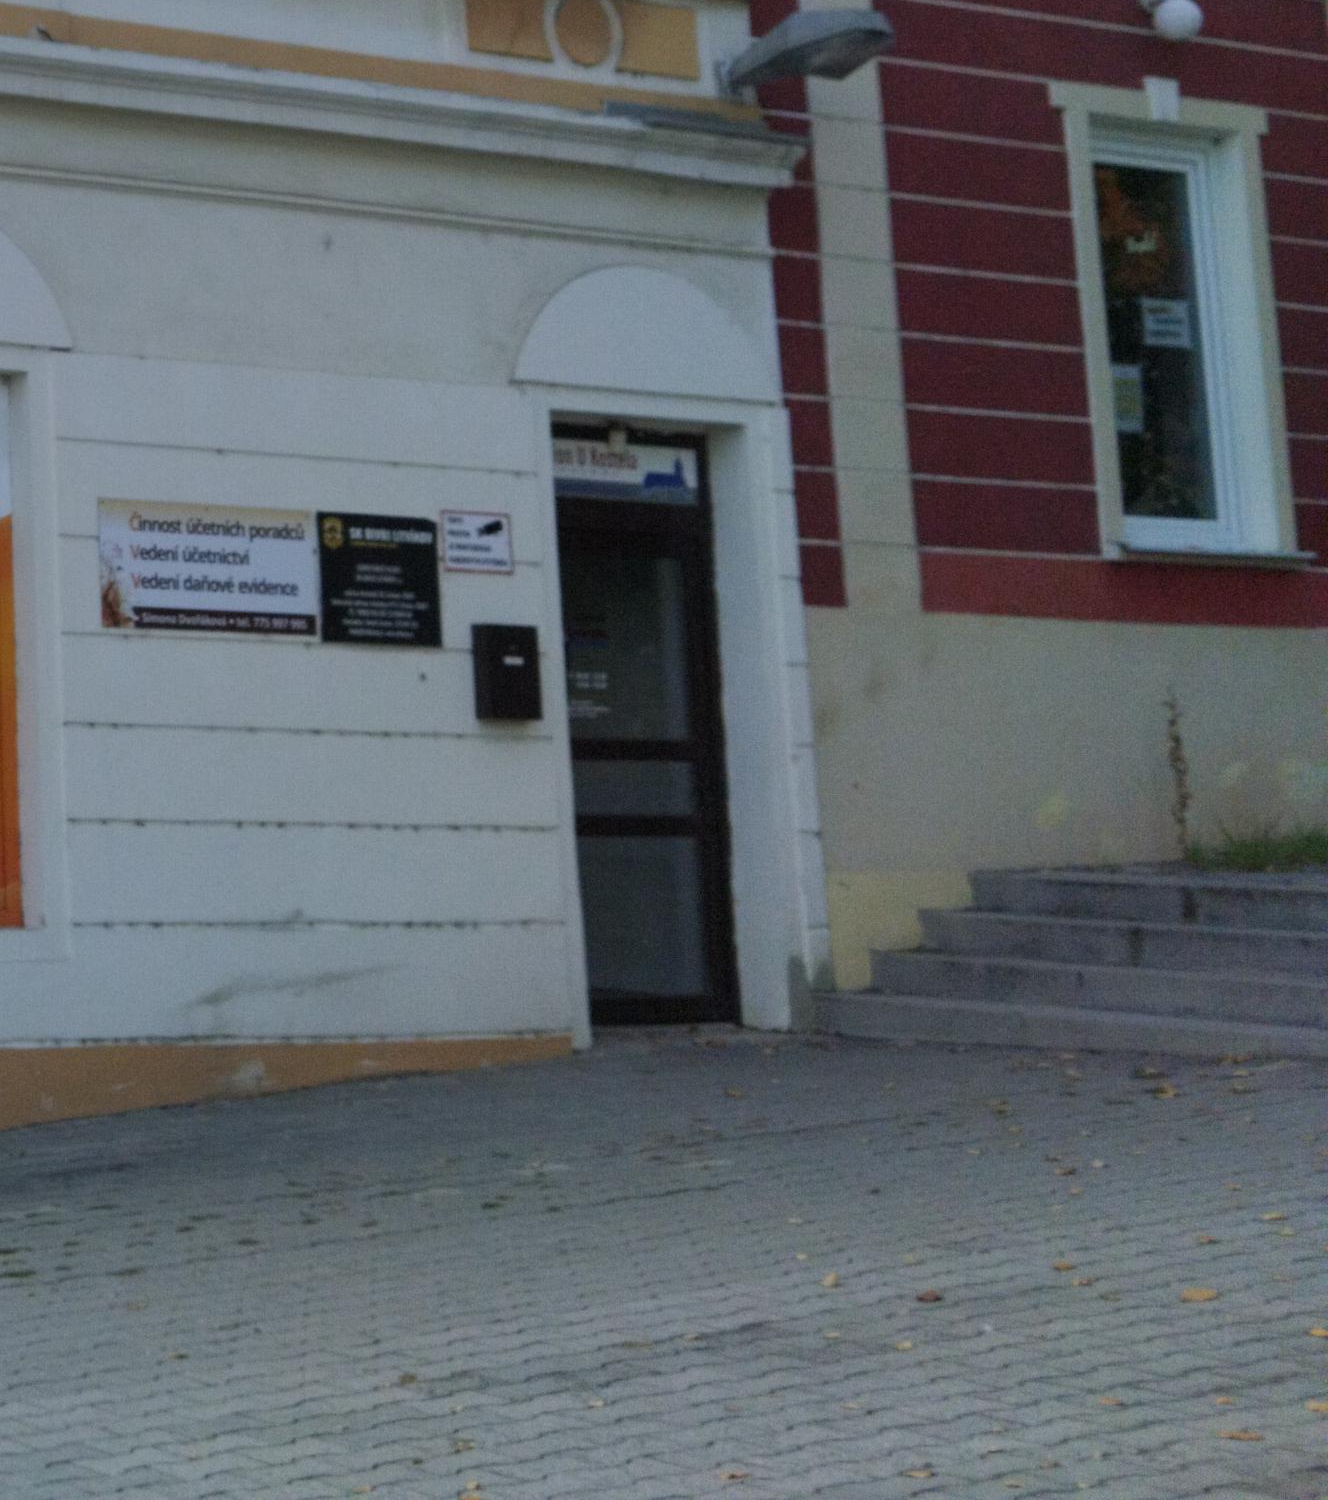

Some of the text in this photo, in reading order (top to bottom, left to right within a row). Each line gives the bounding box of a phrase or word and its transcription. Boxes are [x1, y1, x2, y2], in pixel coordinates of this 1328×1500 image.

[129, 512, 305, 542] Činnost účetních poradců
[129, 543, 250, 565] Vedení účetnictví
[130, 571, 299, 596] Vedení daňové evidence
